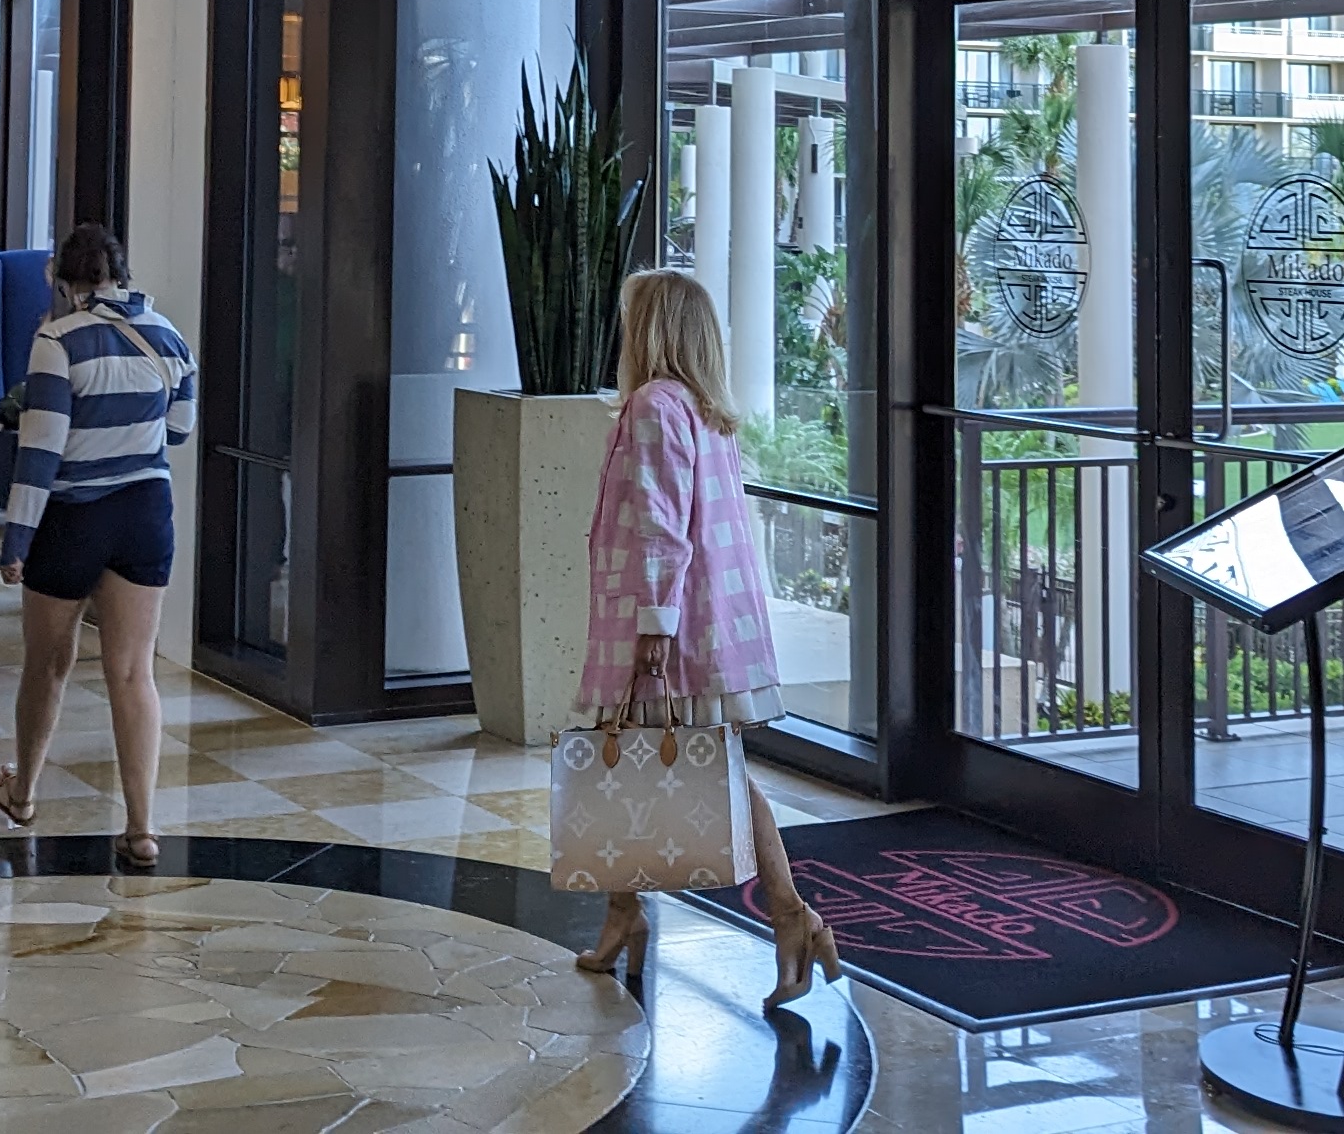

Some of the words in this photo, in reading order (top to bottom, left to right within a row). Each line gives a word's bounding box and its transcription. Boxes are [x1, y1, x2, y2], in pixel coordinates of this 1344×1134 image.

[1013, 244, 1073, 270] Mikado
[1267, 253, 1344, 282] Mikado
[861, 869, 1037, 935] Mikado
